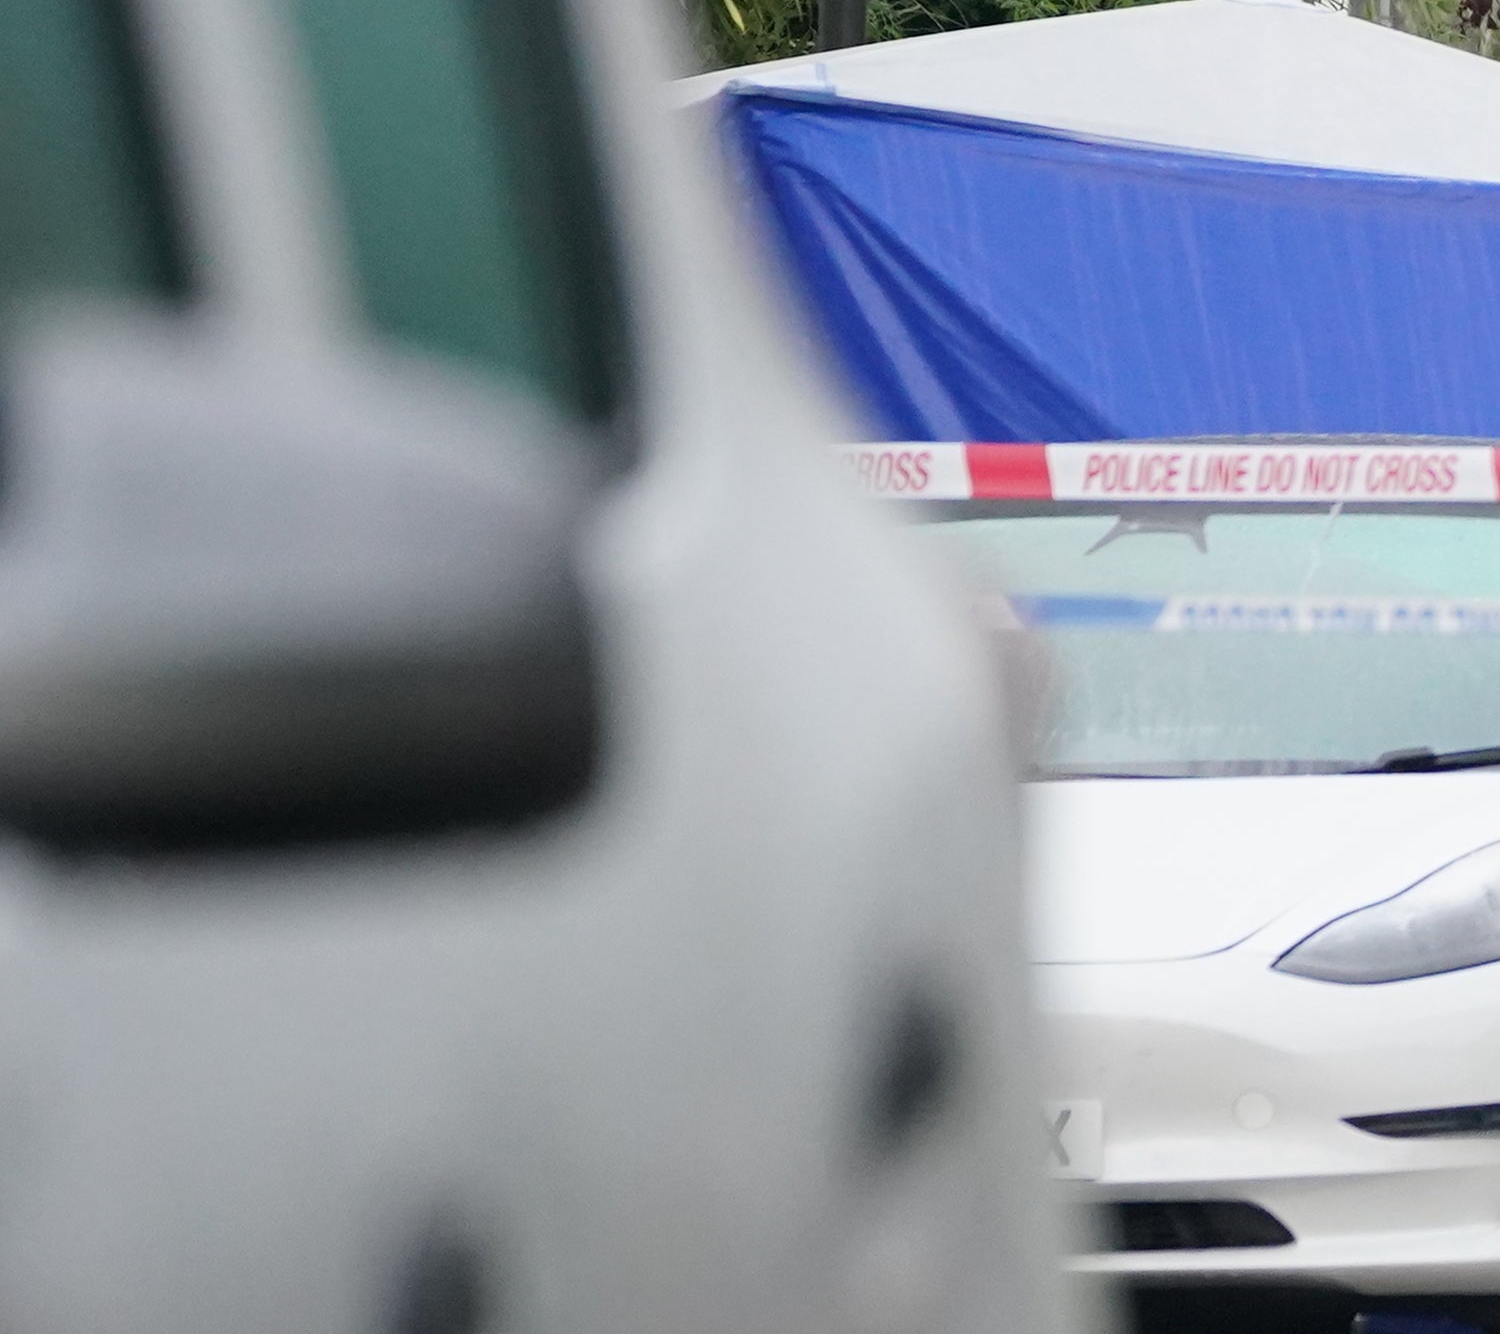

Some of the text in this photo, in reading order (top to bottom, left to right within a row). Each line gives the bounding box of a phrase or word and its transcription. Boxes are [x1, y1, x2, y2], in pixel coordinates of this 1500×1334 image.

[1083, 453, 1459, 495] POLICE LINE DO NOT CROSS
